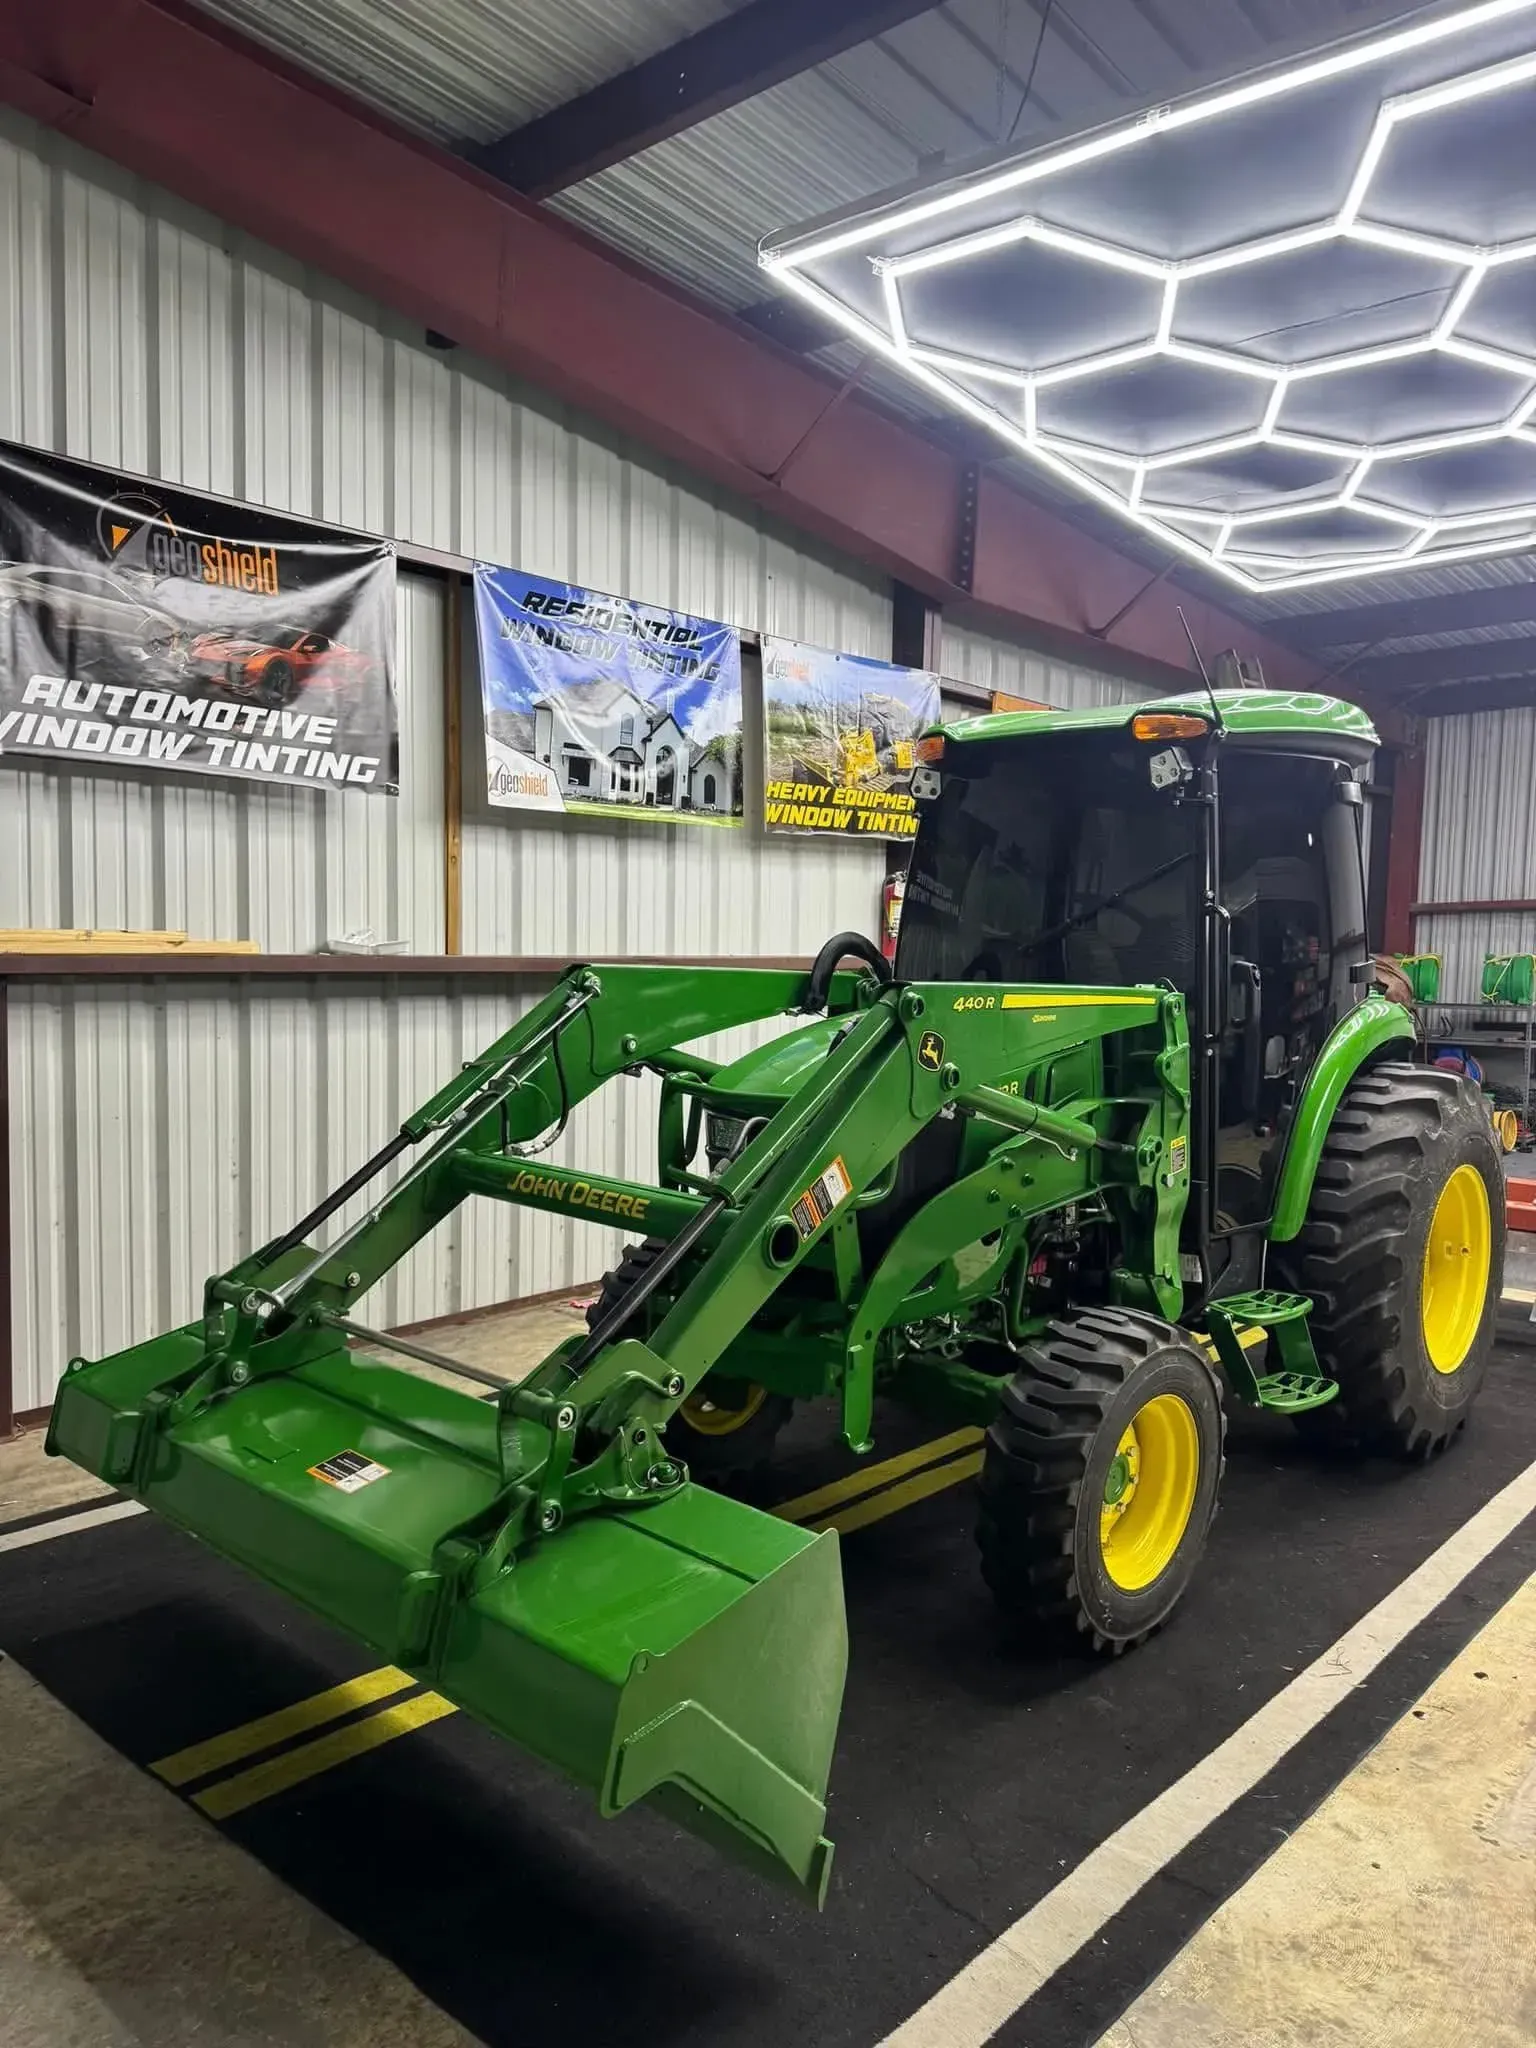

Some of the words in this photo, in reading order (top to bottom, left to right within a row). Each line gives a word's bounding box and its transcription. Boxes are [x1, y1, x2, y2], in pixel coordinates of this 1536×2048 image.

[152, 532, 279, 596] geoshield
[500, 616, 623, 662] WINDOW
[520, 591, 705, 652] RESIDENTIAL
[21, 674, 338, 745] AUTOMOTIVE
[206, 736, 381, 784] TINTING
[500, 771, 548, 797] geoshield
[766, 781, 831, 803] HEAVY
[832, 788, 915, 811] EQUIPMEN
[766, 803, 853, 829] WINDOW
[857, 811, 918, 833] TINTIN
[953, 996, 996, 1012] 440R
[507, 1170, 568, 1200] JOHN
[569, 1182, 650, 1219] DEERE
